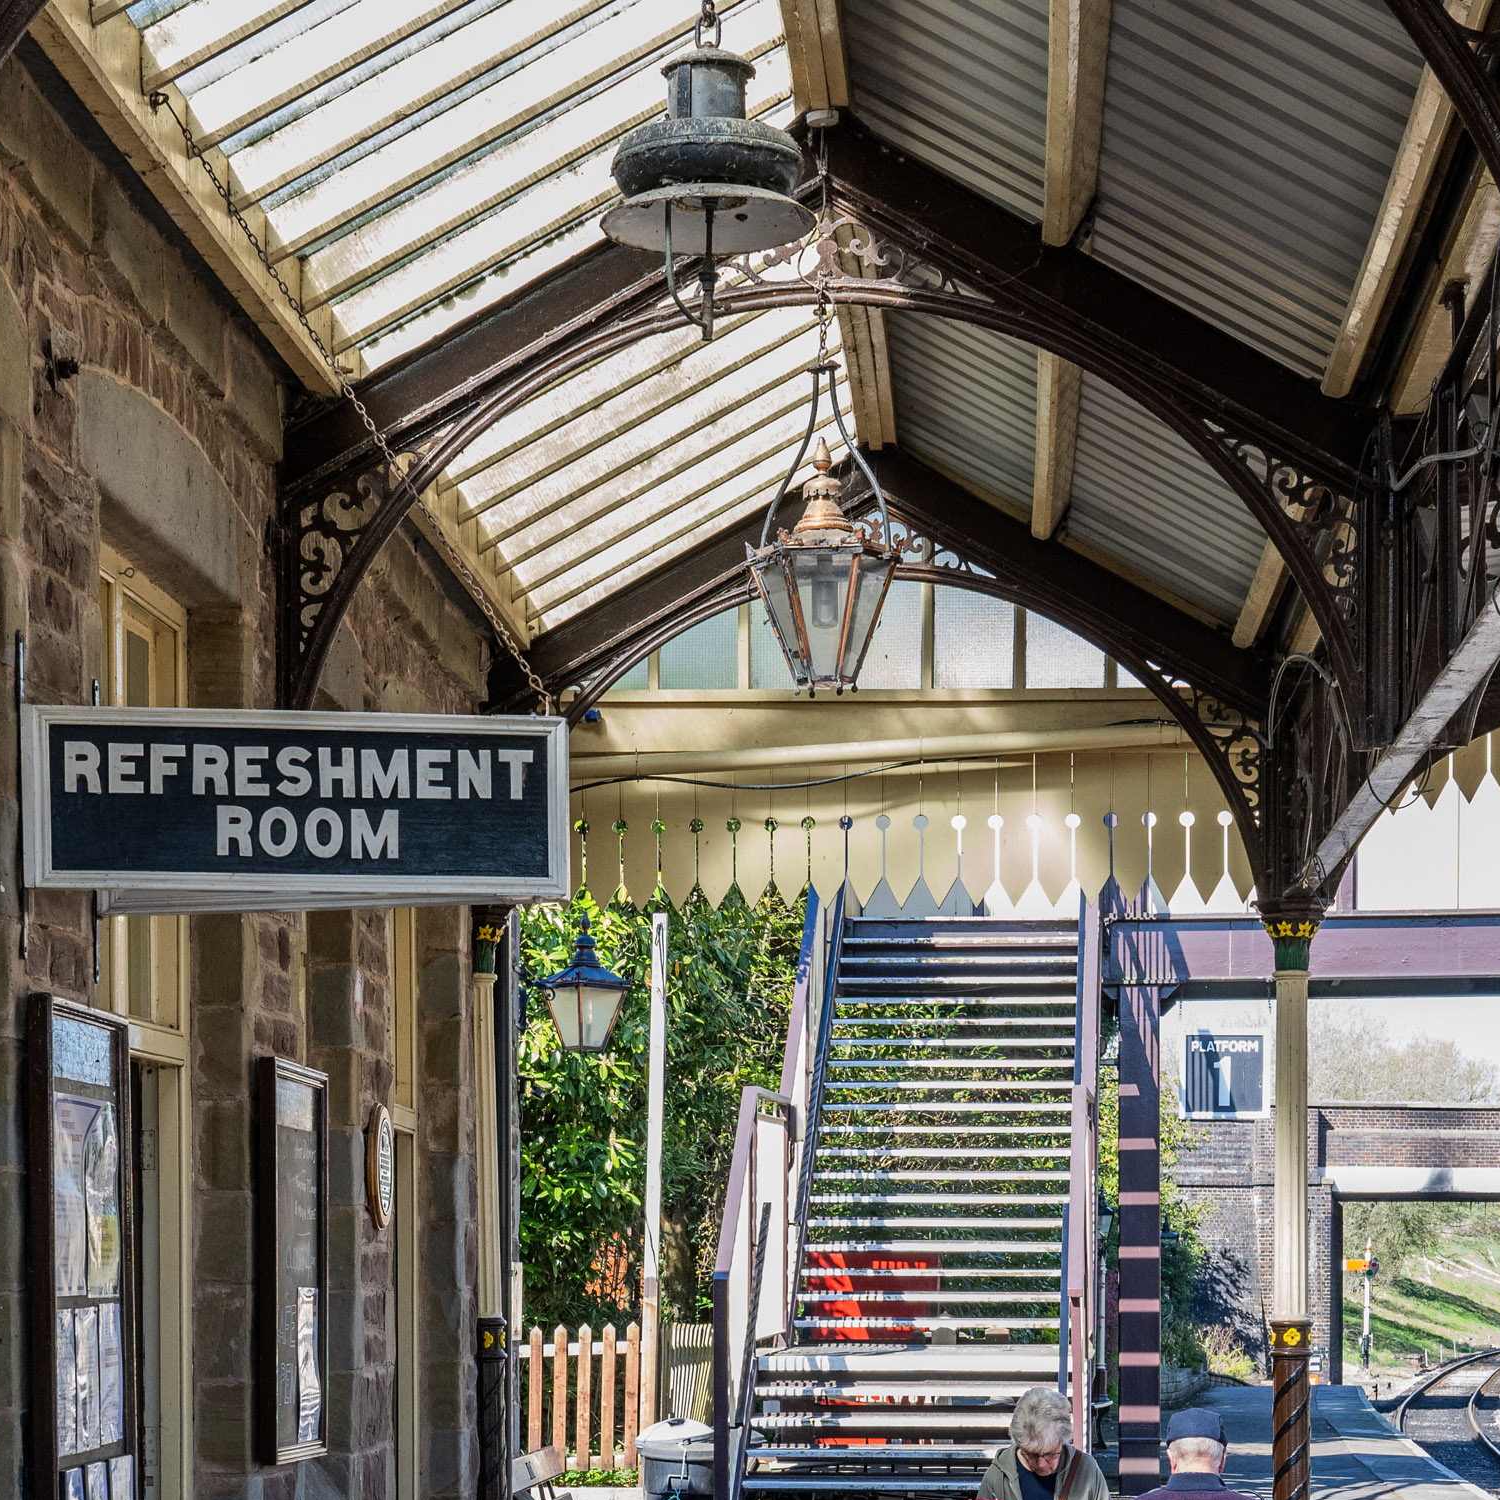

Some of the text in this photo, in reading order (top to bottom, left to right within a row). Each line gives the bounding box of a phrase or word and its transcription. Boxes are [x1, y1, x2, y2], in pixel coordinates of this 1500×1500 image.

[63, 740, 535, 801] REFRESHMENT
[216, 804, 400, 860] ROOM
[1191, 1040, 1259, 1053] PLATFORM
[1213, 1055, 1232, 1107] 1
